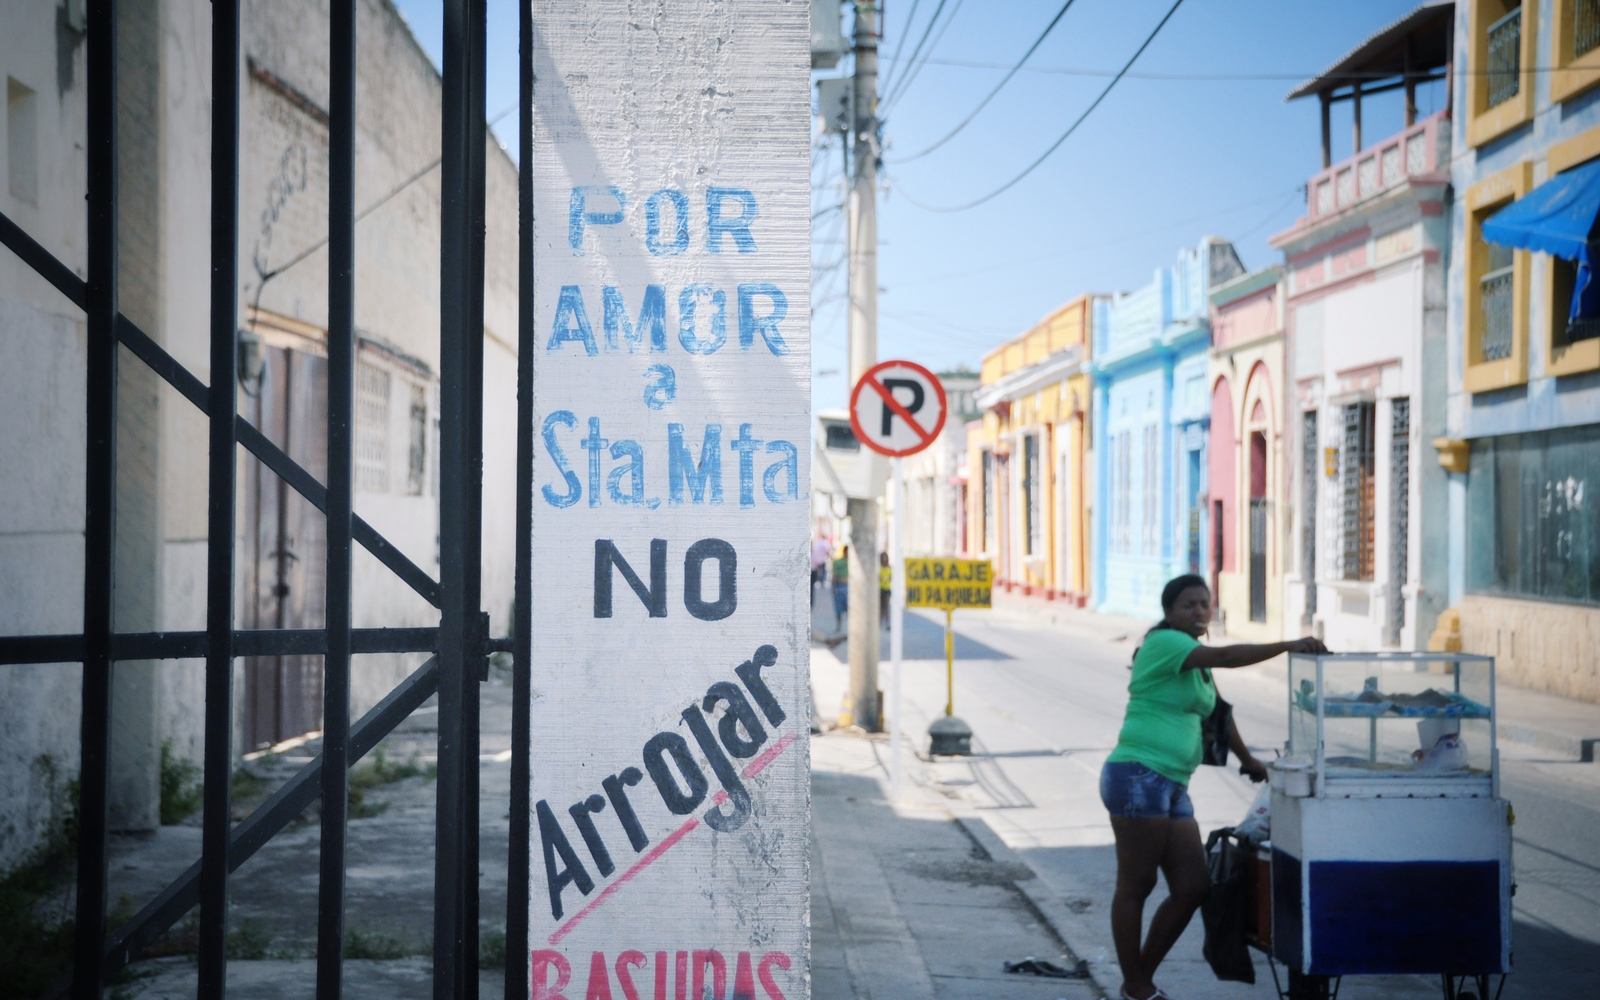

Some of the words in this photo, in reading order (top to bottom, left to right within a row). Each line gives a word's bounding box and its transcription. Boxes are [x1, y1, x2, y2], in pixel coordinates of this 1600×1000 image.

[569, 185, 759, 256] POR
[547, 283, 788, 356] AMOR
[643, 363, 677, 410] a
[593, 538, 737, 621] NO
[908, 561, 987, 581] GARAJE
